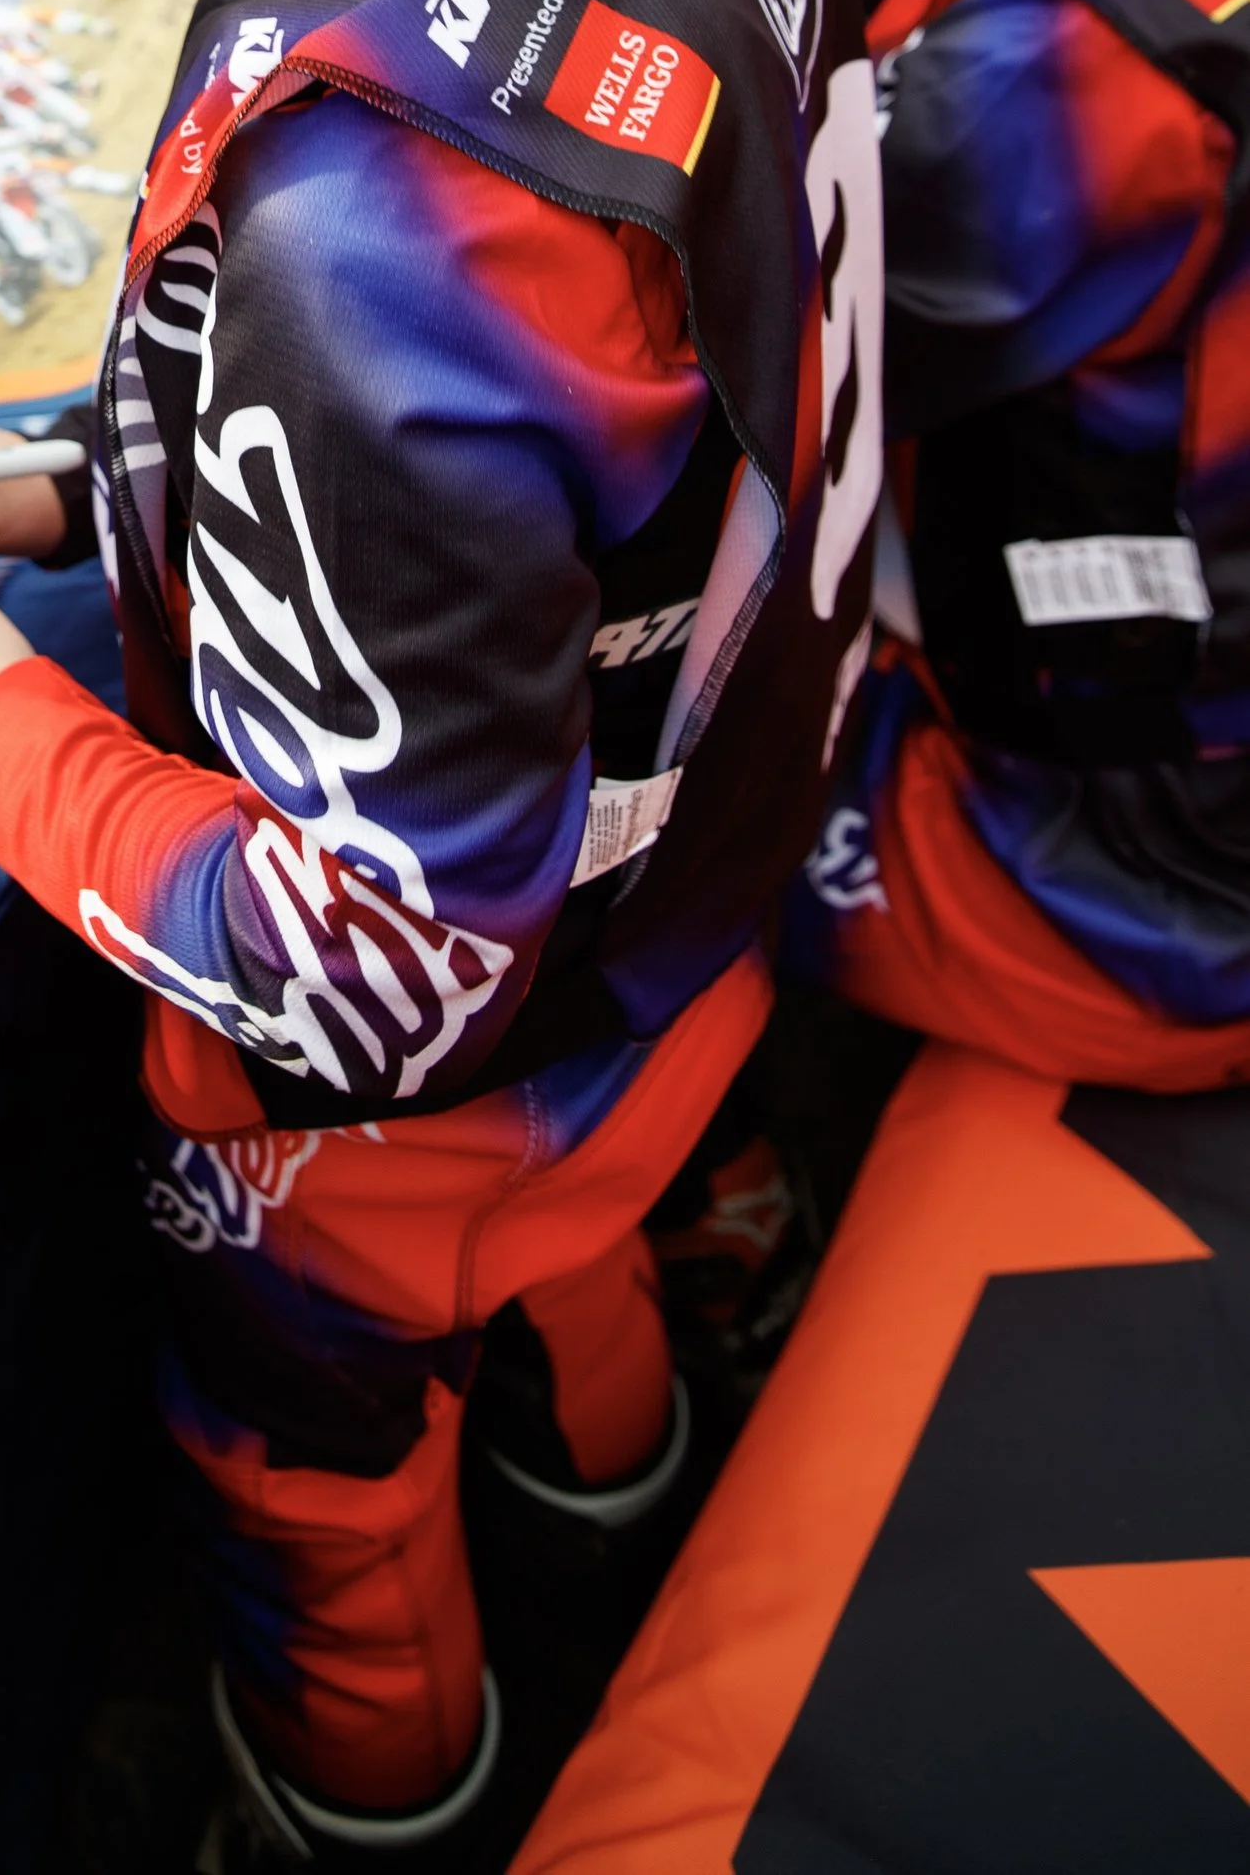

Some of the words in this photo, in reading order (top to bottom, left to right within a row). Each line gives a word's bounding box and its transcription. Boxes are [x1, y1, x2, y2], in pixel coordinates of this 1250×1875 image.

[584, 29, 647, 128] WELLS
[618, 43, 681, 142] FARGO
[181, 140, 207, 175] by
